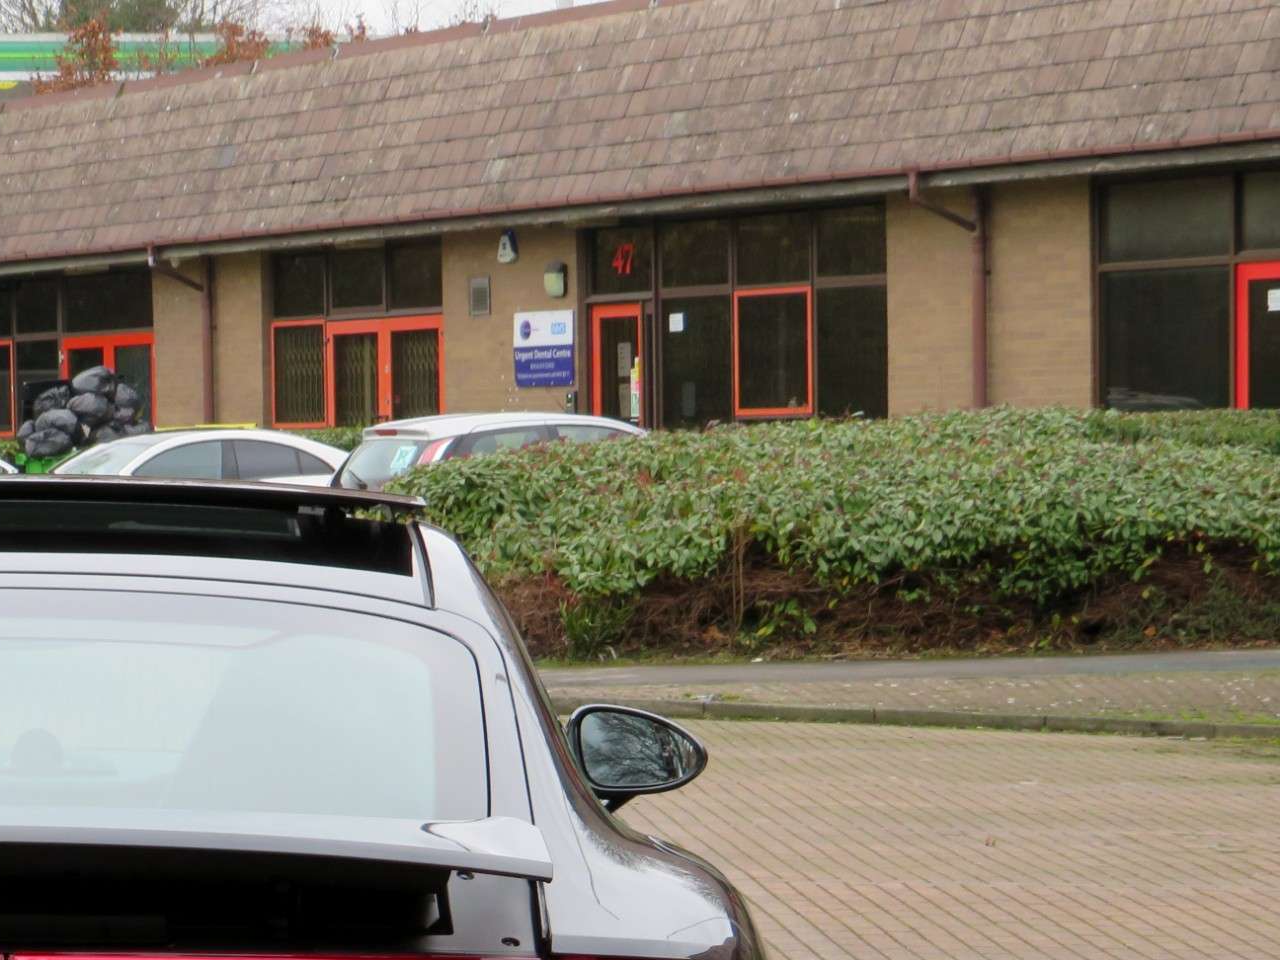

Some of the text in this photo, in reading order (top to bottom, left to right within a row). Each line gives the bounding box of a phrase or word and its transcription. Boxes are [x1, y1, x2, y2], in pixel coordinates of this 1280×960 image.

[612, 243, 635, 274] 47
[515, 351, 533, 362] Urgent
[534, 349, 552, 360] Dental
